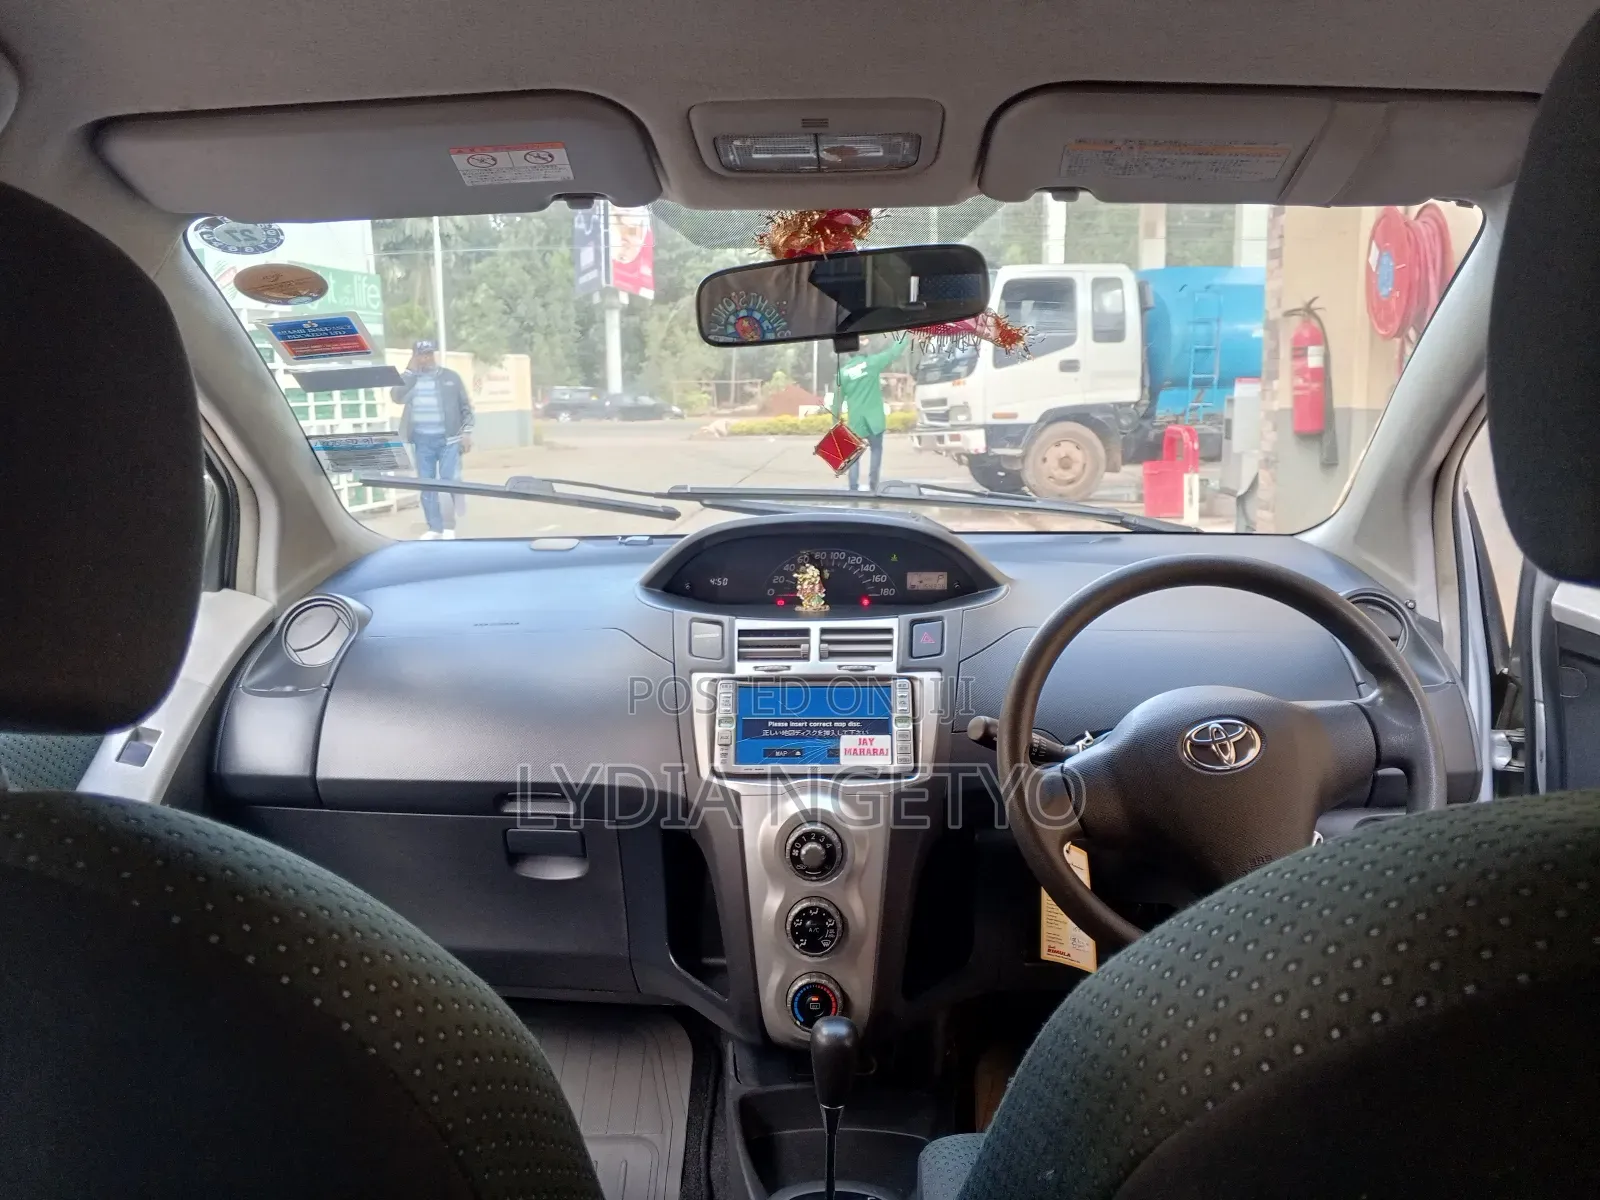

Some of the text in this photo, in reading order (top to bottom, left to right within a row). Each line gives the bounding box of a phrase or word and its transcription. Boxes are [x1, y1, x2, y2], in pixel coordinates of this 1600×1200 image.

[353, 273, 381, 310] life
[797, 555, 810, 564] 60
[814, 551, 827, 560] 80
[830, 551, 846, 560] 100
[847, 556, 862, 564] 120
[783, 564, 796, 572] 40
[860, 564, 875, 572] 140
[709, 577, 728, 586] 4:50
[772, 575, 785, 584] 20
[872, 575, 887, 583] 160
[767, 588, 775, 596] 0
[880, 588, 895, 596] 180
[857, 737, 875, 746] JAY
[844, 747, 889, 756] MAHARAJ
[819, 835, 826, 843] 3
